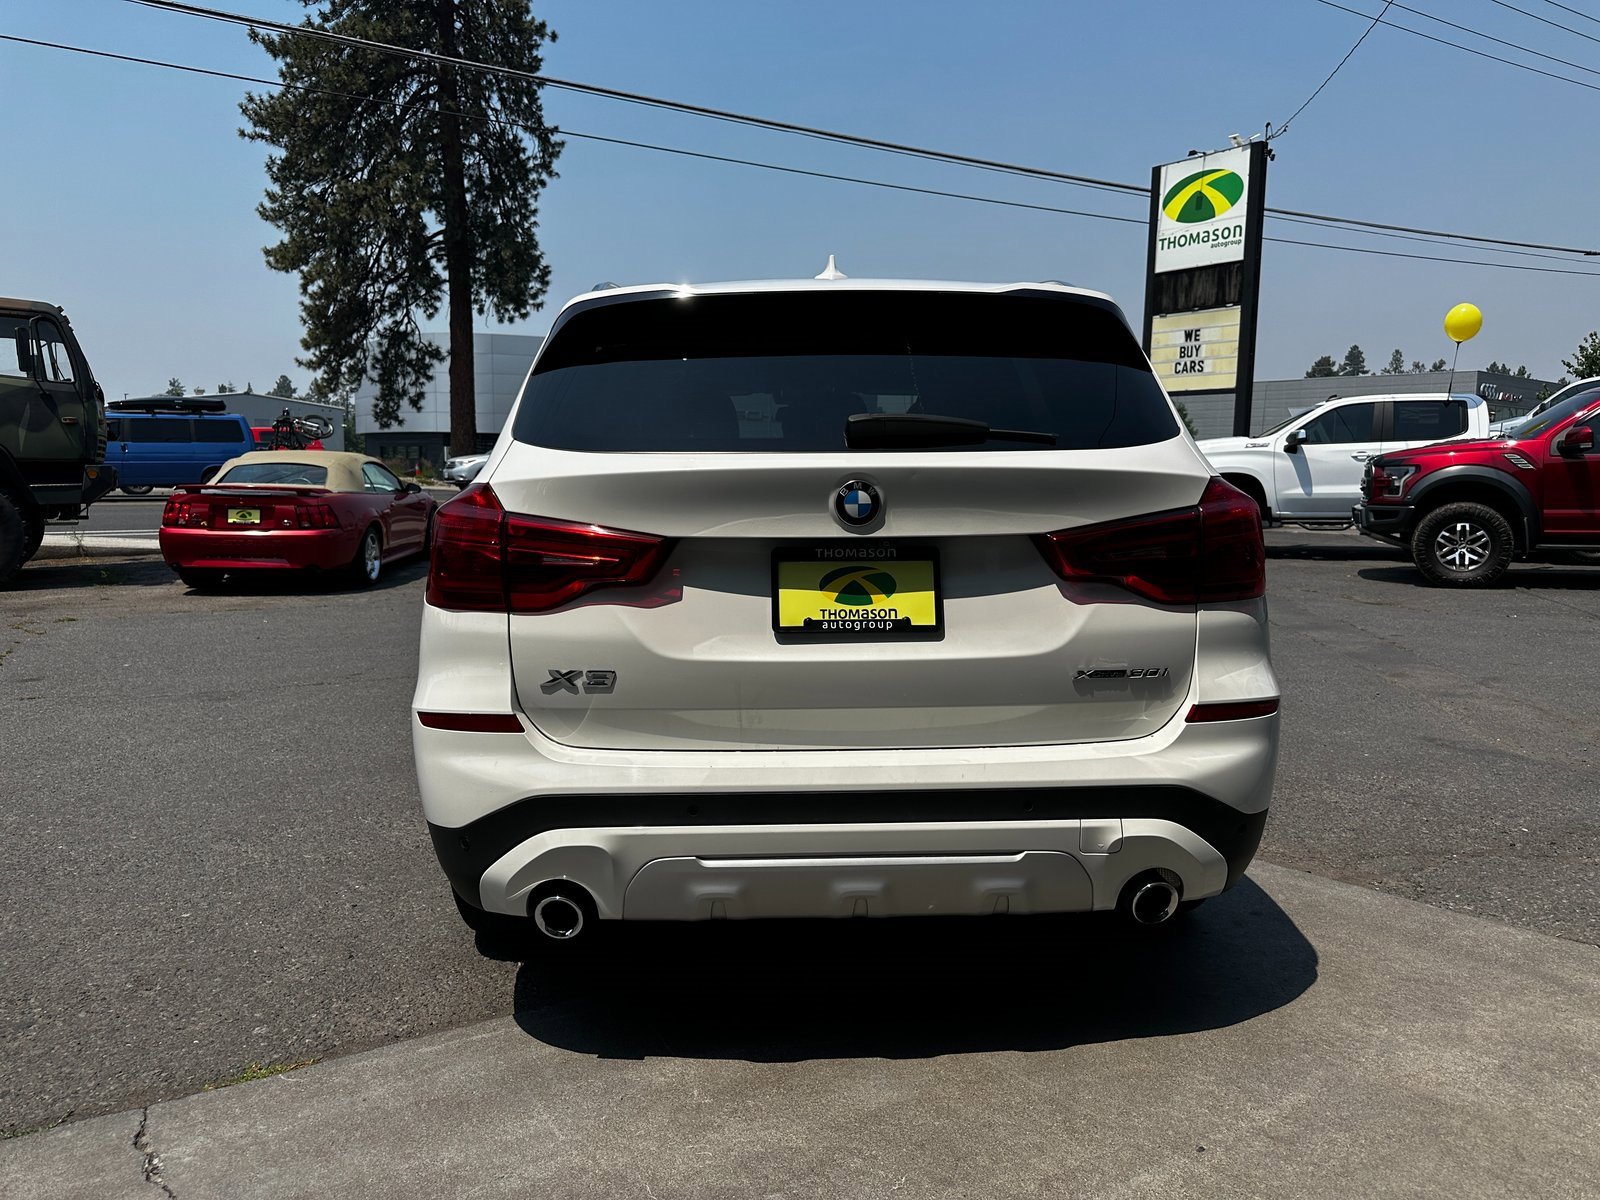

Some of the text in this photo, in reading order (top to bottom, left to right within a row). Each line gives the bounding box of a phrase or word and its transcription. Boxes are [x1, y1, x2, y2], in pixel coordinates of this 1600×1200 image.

[1210, 239, 1242, 249] autogroup
[1184, 329, 1200, 342] WE
[1179, 345, 1201, 359] BUY
[1174, 360, 1204, 374] CARS
[840, 482, 877, 496] BMW
[822, 621, 893, 631] autogroup
[540, 669, 617, 690] X3
